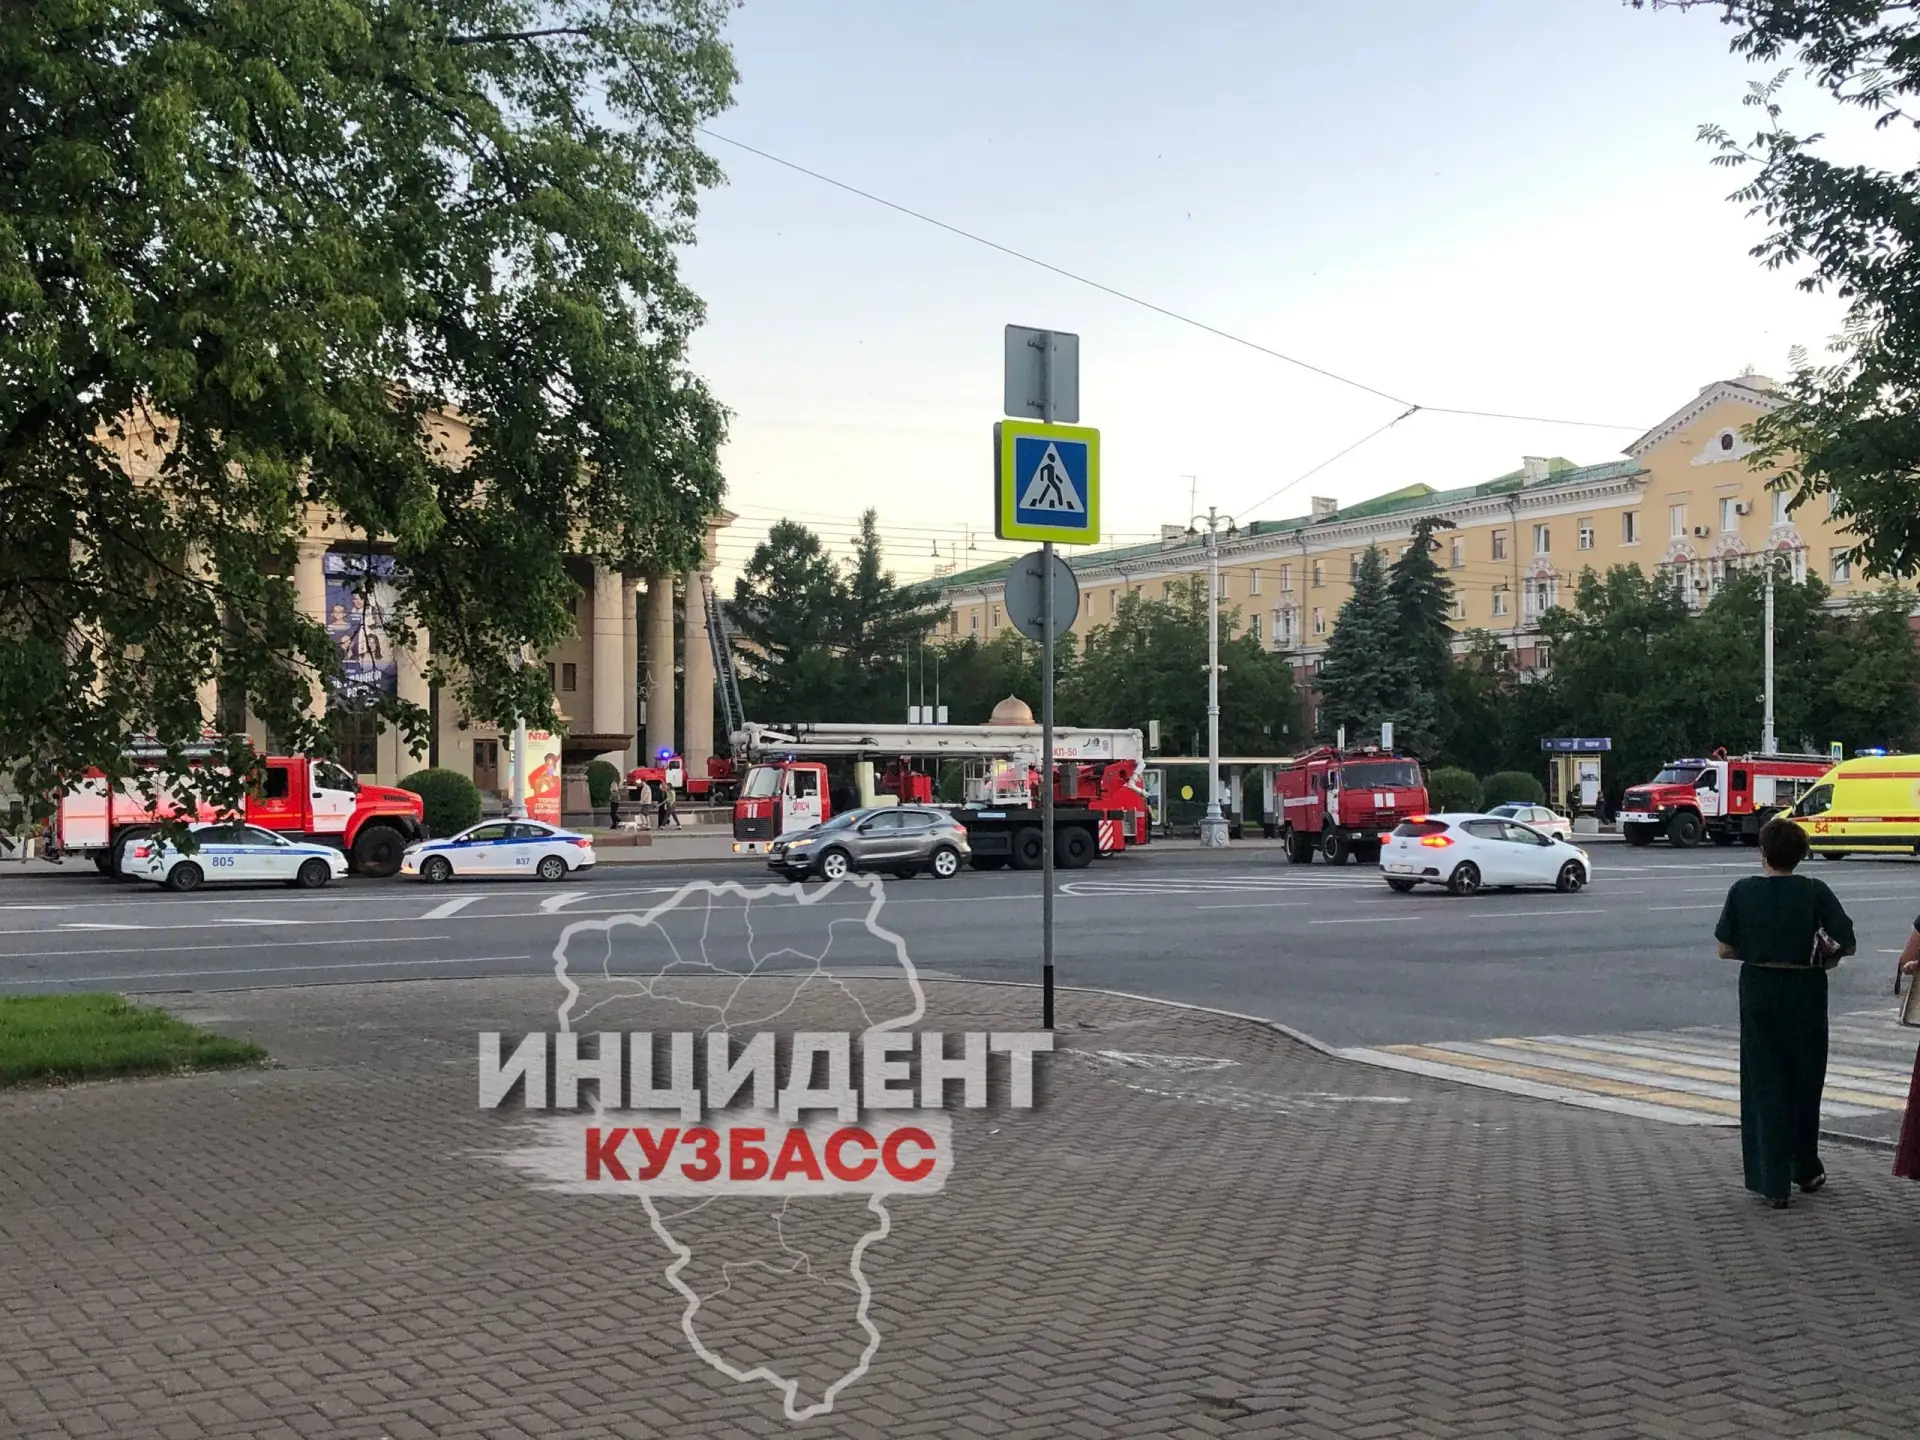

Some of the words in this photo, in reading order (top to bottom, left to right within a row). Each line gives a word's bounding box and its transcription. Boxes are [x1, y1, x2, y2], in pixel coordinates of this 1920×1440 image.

[1052, 747, 1078, 757] КП-50
[1814, 821, 1829, 833] 54
[211, 856, 235, 867] 805
